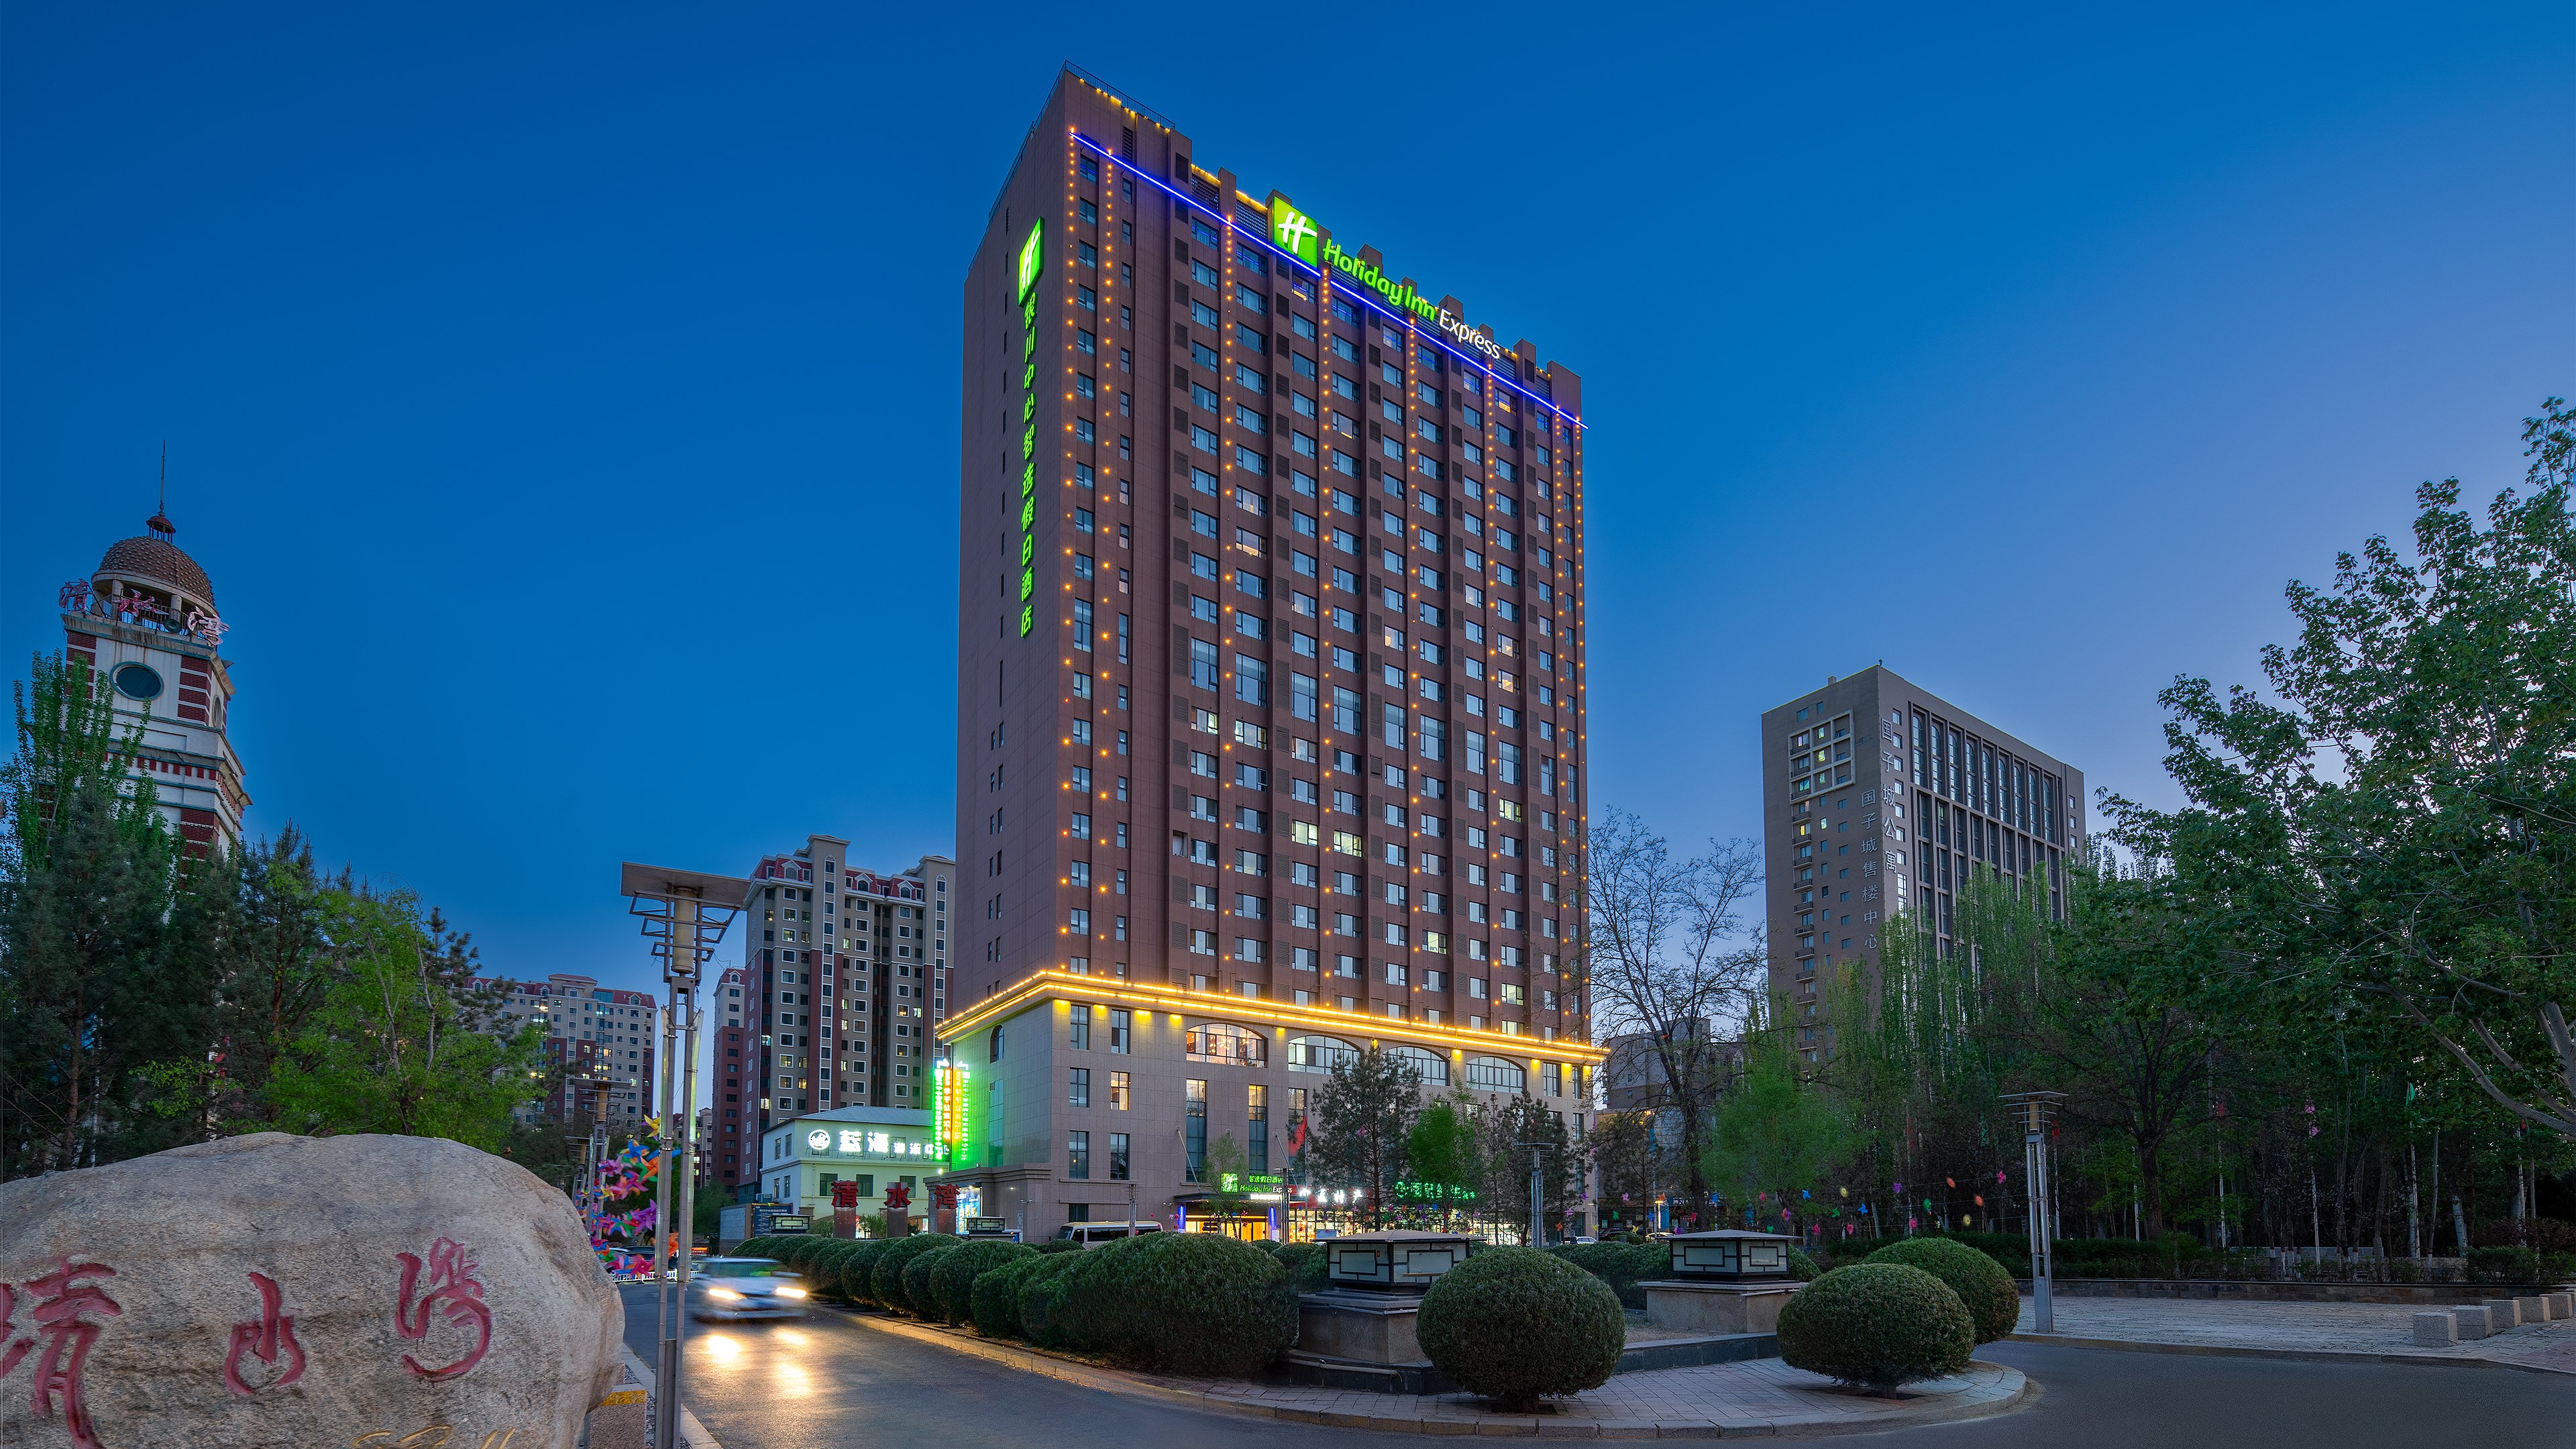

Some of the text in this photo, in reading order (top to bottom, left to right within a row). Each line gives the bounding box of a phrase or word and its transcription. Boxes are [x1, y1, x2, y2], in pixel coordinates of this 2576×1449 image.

[1322, 237, 1501, 360] Holiday Inn Express
[1020, 291, 1037, 639] 银川中心智选假日酒店
[1880, 718, 1897, 874] 国子城公寓
[1861, 788, 1878, 950] 国子城售楼中心
[830, 1180, 960, 1210] 清水湾
[1240, 1184, 1263, 1193] Holiday
